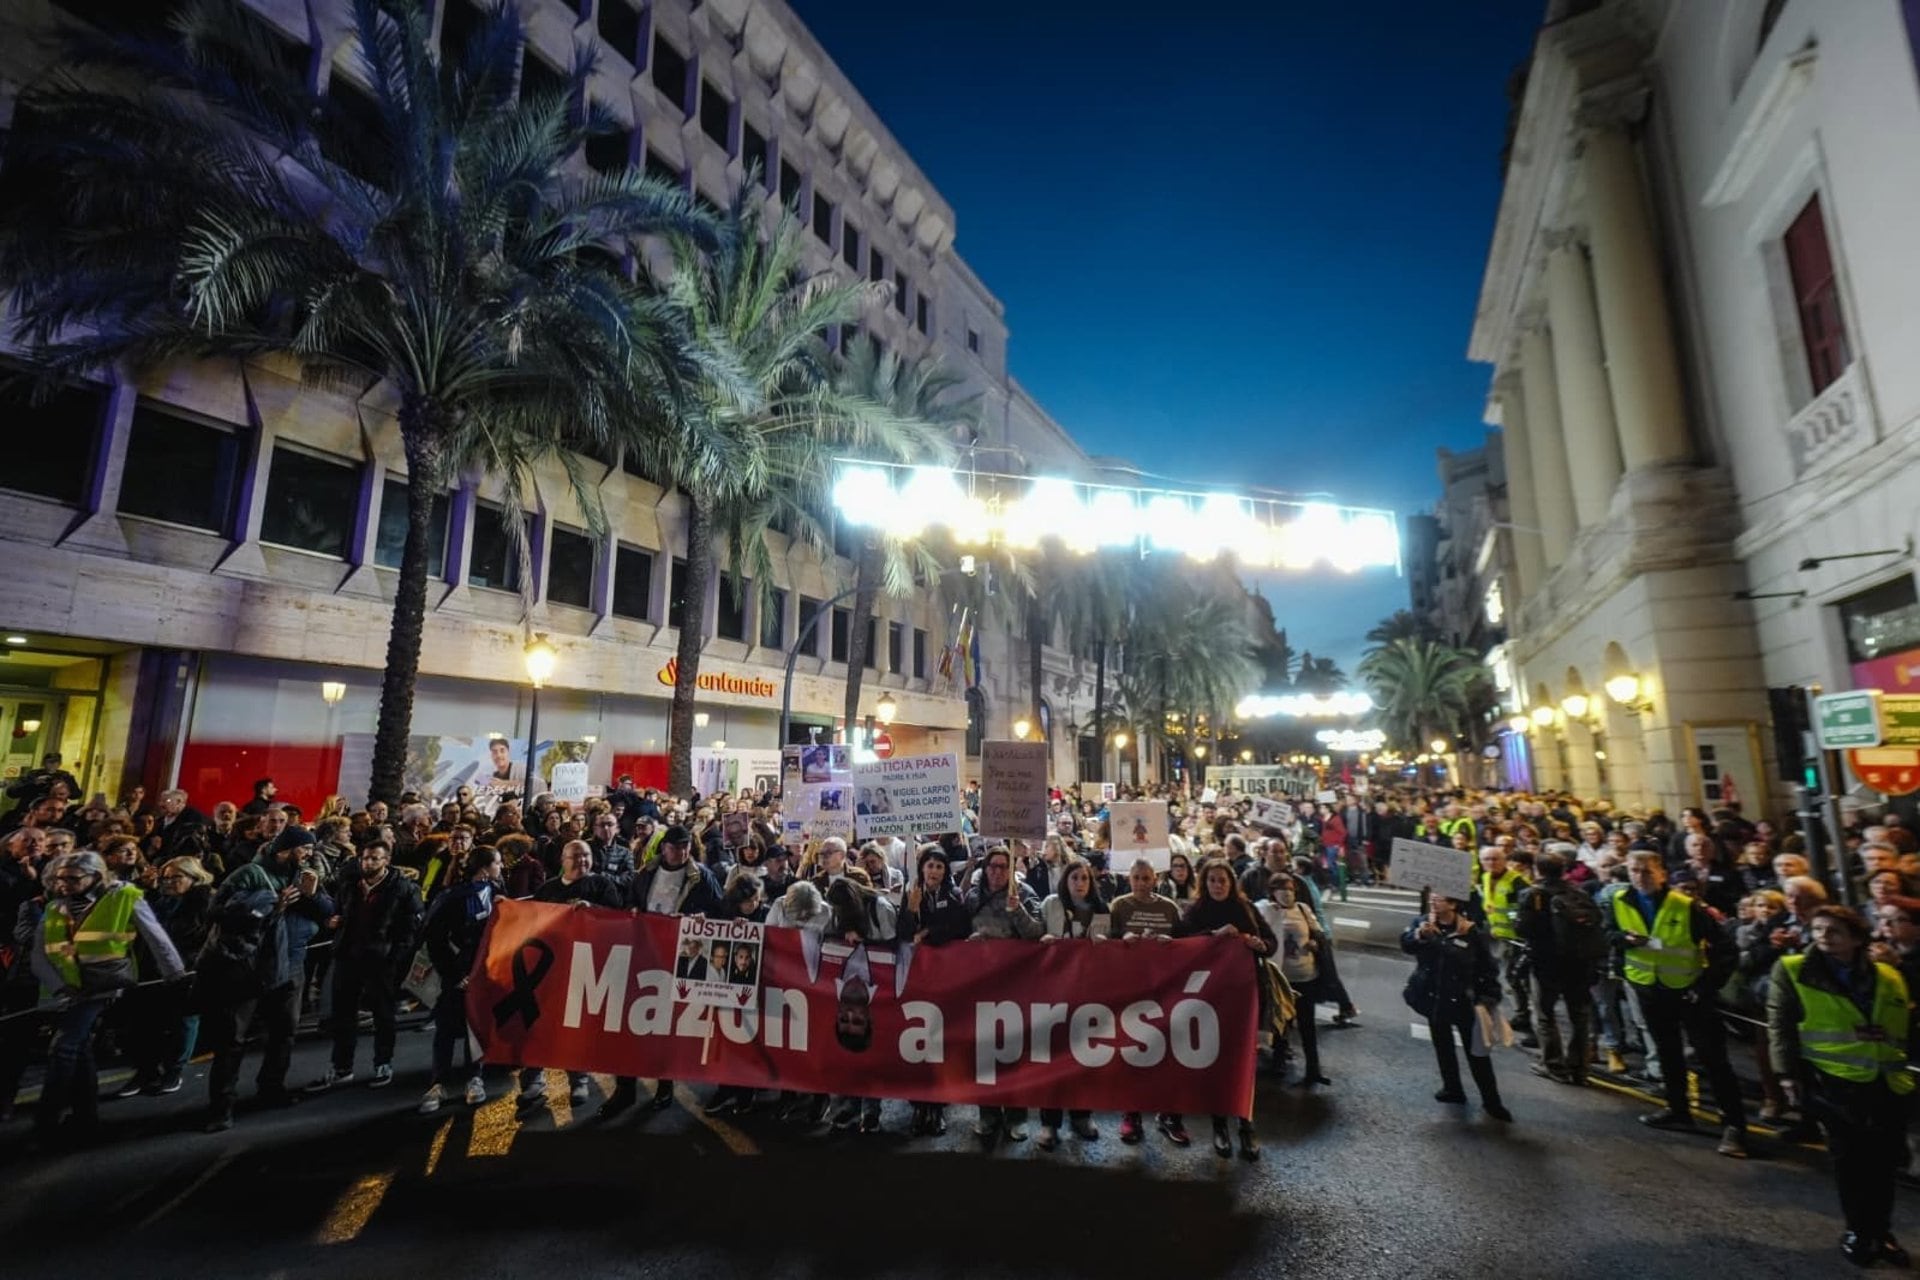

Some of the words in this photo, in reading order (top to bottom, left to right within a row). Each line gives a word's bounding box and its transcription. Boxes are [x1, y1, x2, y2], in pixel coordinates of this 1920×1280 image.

[697, 671, 775, 698] antander
[858, 760, 913, 774] JUSTICIA
[915, 757, 950, 769] PARA
[893, 788, 919, 797] MIGUEL
[901, 798, 921, 807] SARA
[871, 815, 898, 823] TODAS
[899, 814, 914, 822] LAS
[870, 823, 904, 834] MAZÓN
[911, 820, 949, 832] PRISIÓN
[682, 921, 760, 940] JUSTICIA
[899, 1000, 945, 1064] a
[975, 970, 1220, 1085] presó
